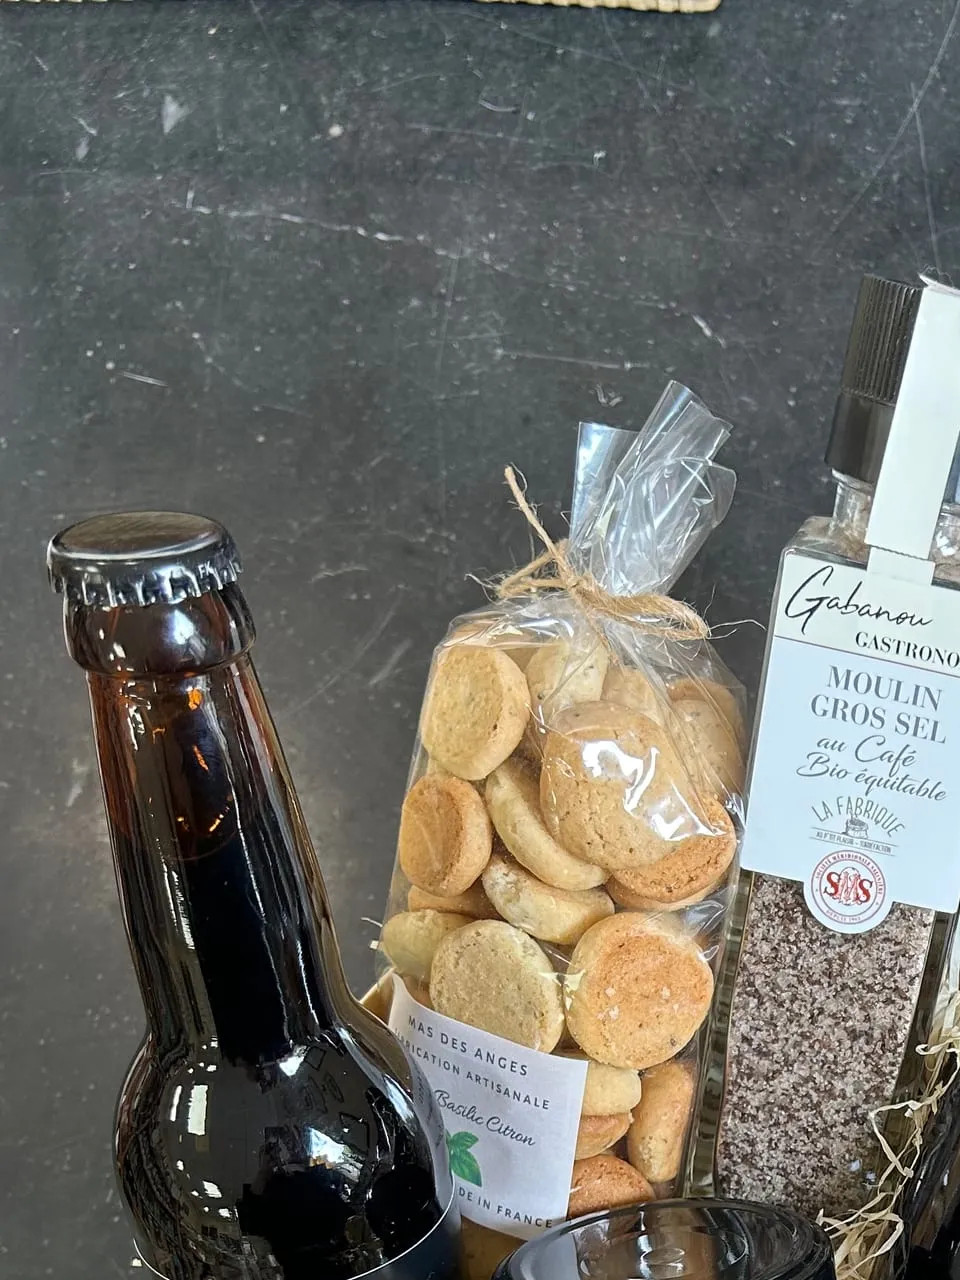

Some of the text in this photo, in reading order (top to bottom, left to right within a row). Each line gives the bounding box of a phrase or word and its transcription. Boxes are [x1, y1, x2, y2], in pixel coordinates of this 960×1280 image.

[784, 565, 932, 635] Gabanou
[828, 665, 943, 713] MOULIN
[810, 693, 948, 744] GROS SEL
[796, 751, 948, 804] Bio équitable
[816, 735, 917, 777] au Café
[811, 796, 906, 838] LA FABRIQUE
[409, 1015, 529, 1077] MAS DES ANGES
[466, 1070, 550, 1110] ARTISANALE
[433, 1089, 537, 1147] Basilic Citron
[478, 1195, 553, 1230] IN FRANCE
